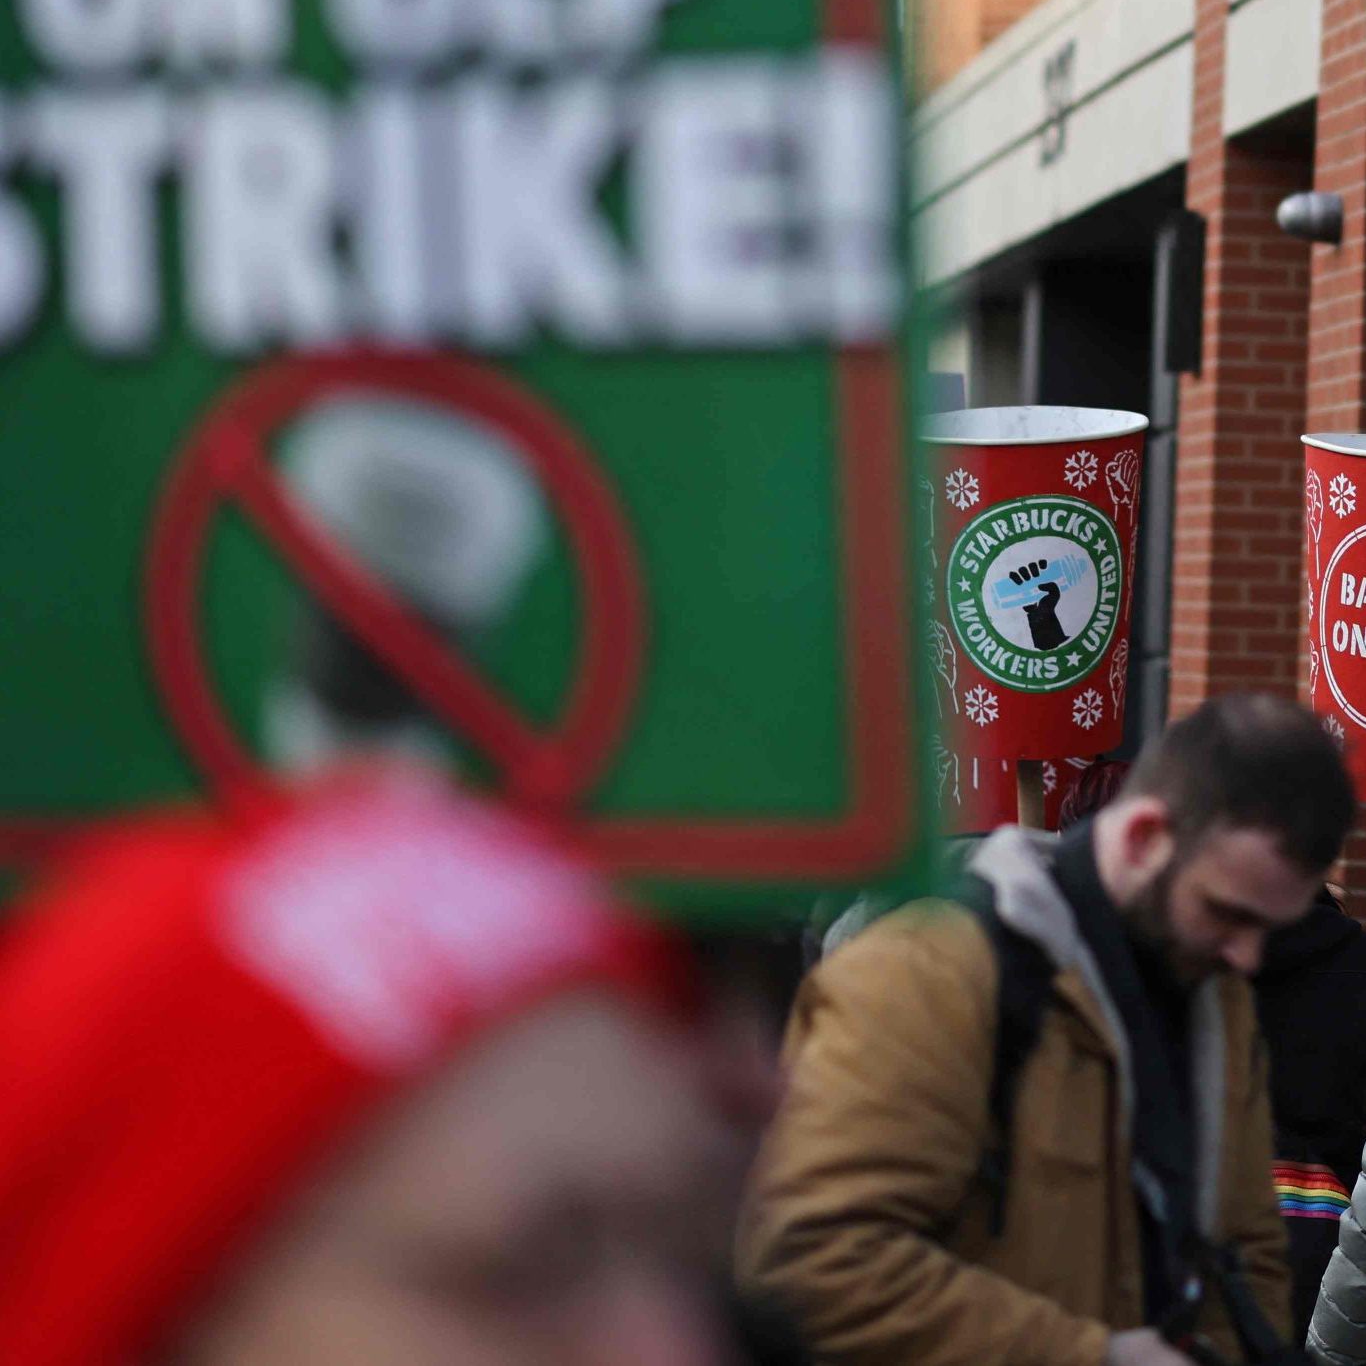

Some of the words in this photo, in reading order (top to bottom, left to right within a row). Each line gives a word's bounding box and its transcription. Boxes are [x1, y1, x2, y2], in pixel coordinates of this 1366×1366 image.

[959, 508, 1099, 574] STARBUCKS
[957, 598, 1060, 679] WORKERS
[1082, 554, 1117, 652] UNITED
